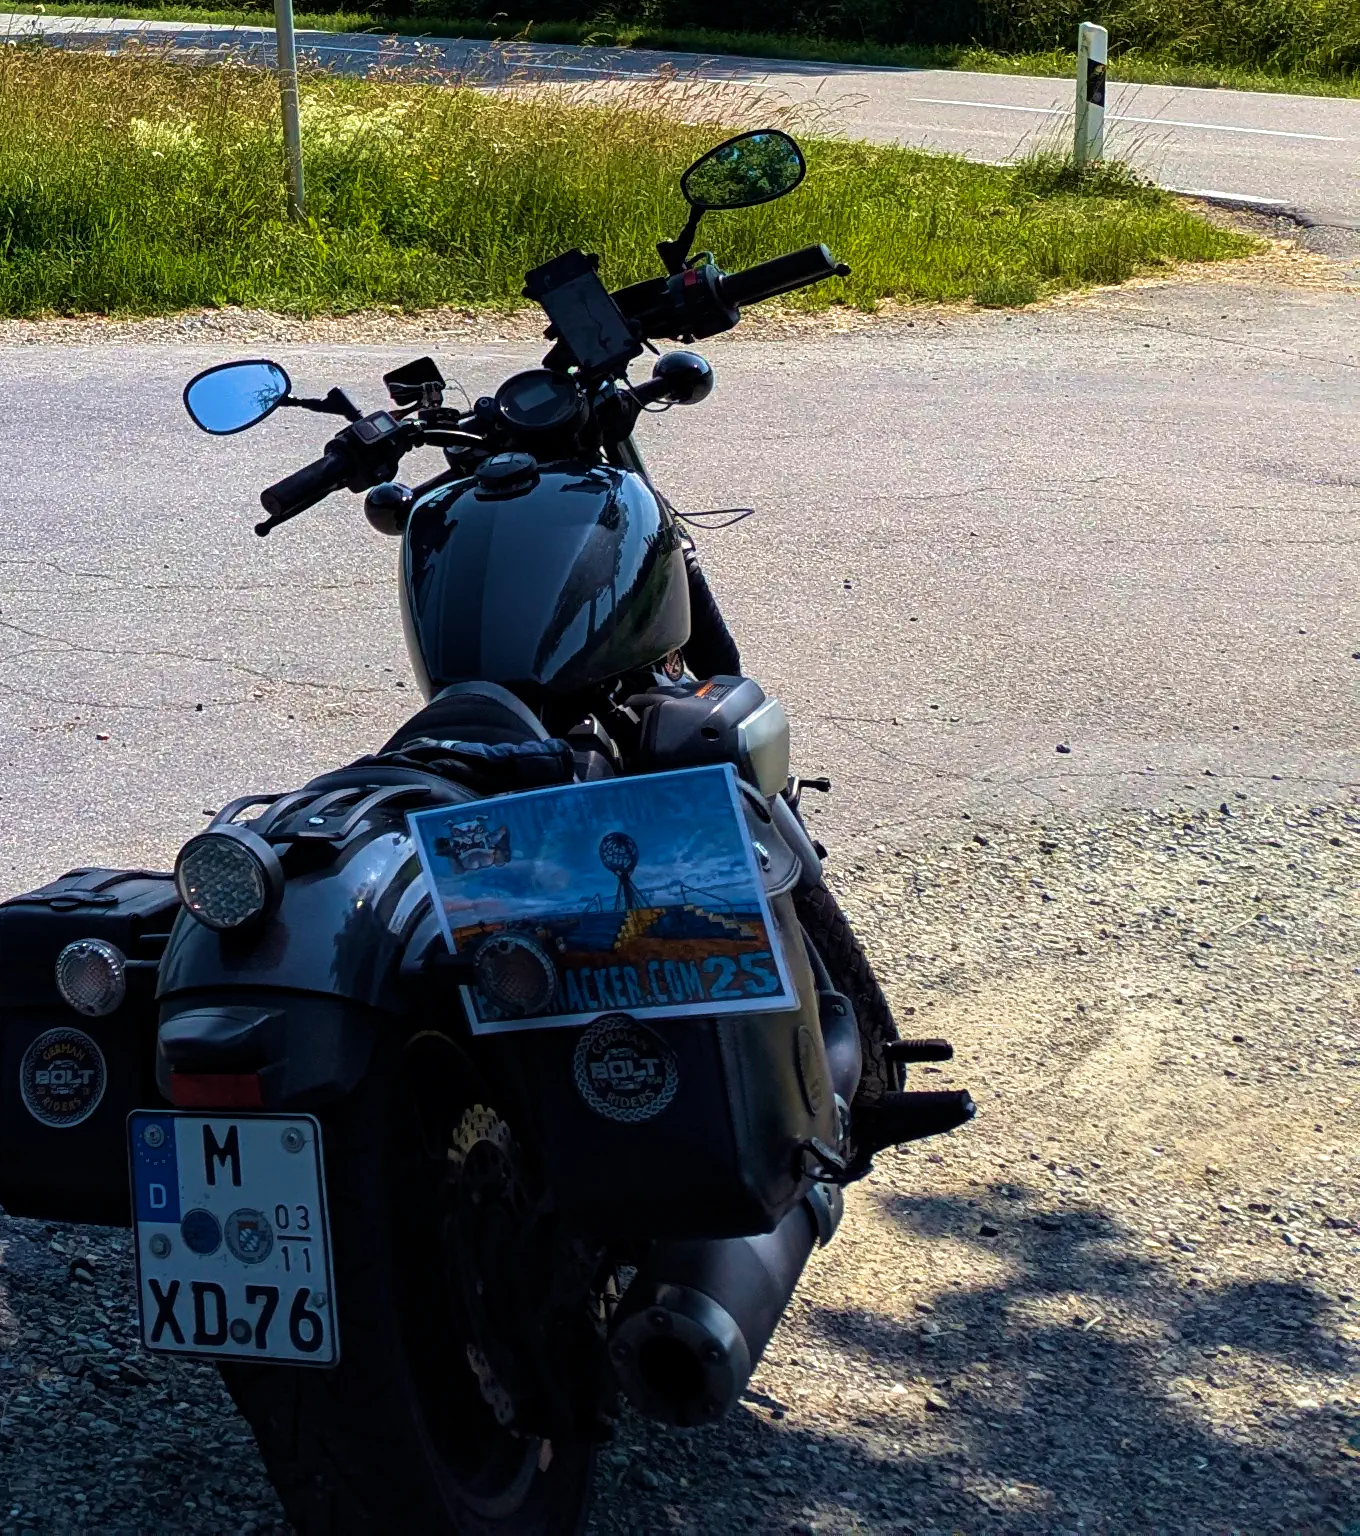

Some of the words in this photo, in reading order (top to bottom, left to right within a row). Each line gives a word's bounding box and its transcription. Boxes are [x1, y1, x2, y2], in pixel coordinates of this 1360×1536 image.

[705, 952, 779, 997] 25
[42, 1043, 86, 1061] GERMAN
[36, 1070, 94, 1084] BOLT
[590, 1059, 658, 1078] BOLT
[42, 1096, 82, 1112] RIDERS
[606, 1089, 656, 1107] RIDERS
[202, 1124, 242, 1187] M
[149, 1183, 167, 1208] D
[275, 1204, 310, 1230] 03
[281, 1246, 311, 1273] 11
[148, 1278, 228, 1346] XD
[246, 1285, 323, 1353] 76
